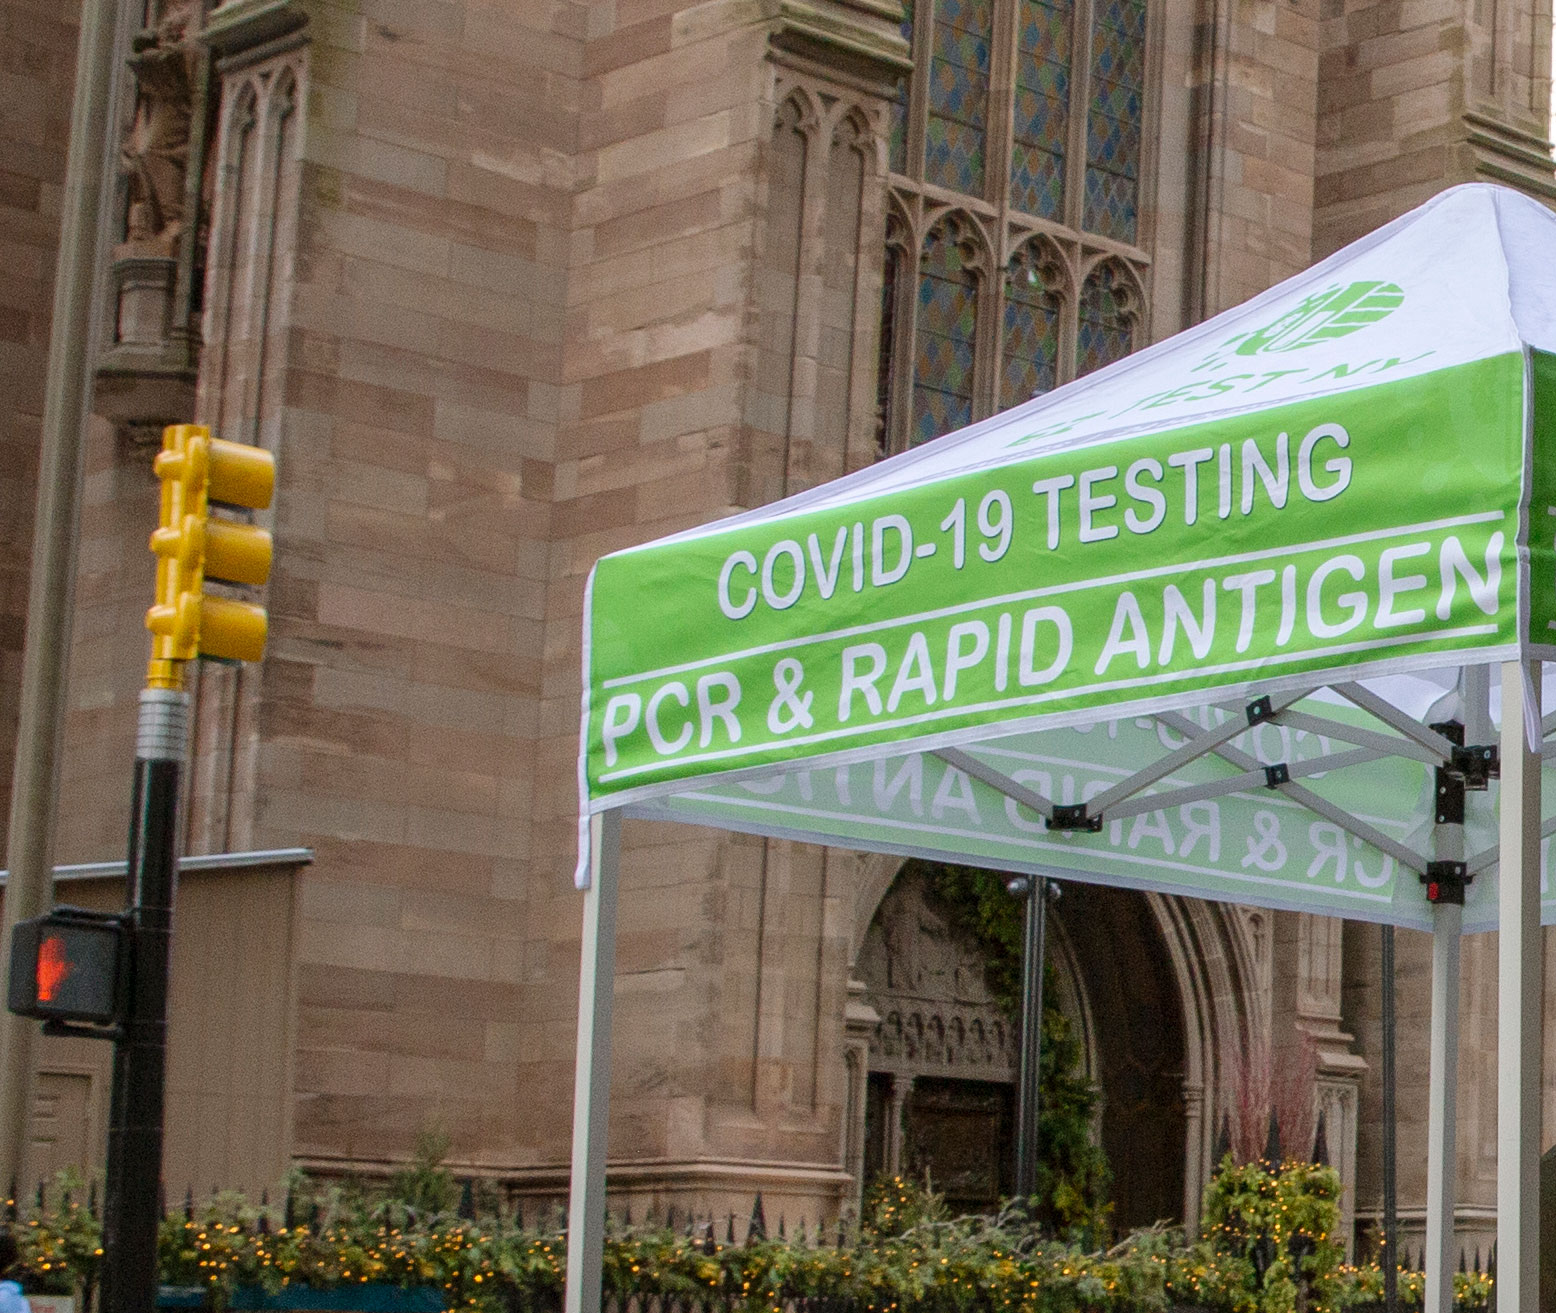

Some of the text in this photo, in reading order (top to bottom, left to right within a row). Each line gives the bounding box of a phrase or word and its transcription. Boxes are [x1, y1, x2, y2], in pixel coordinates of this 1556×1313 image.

[718, 423, 1353, 620] COVID-19 TESTING
[601, 530, 1503, 769] PCR & RAPID ANTIGEN
